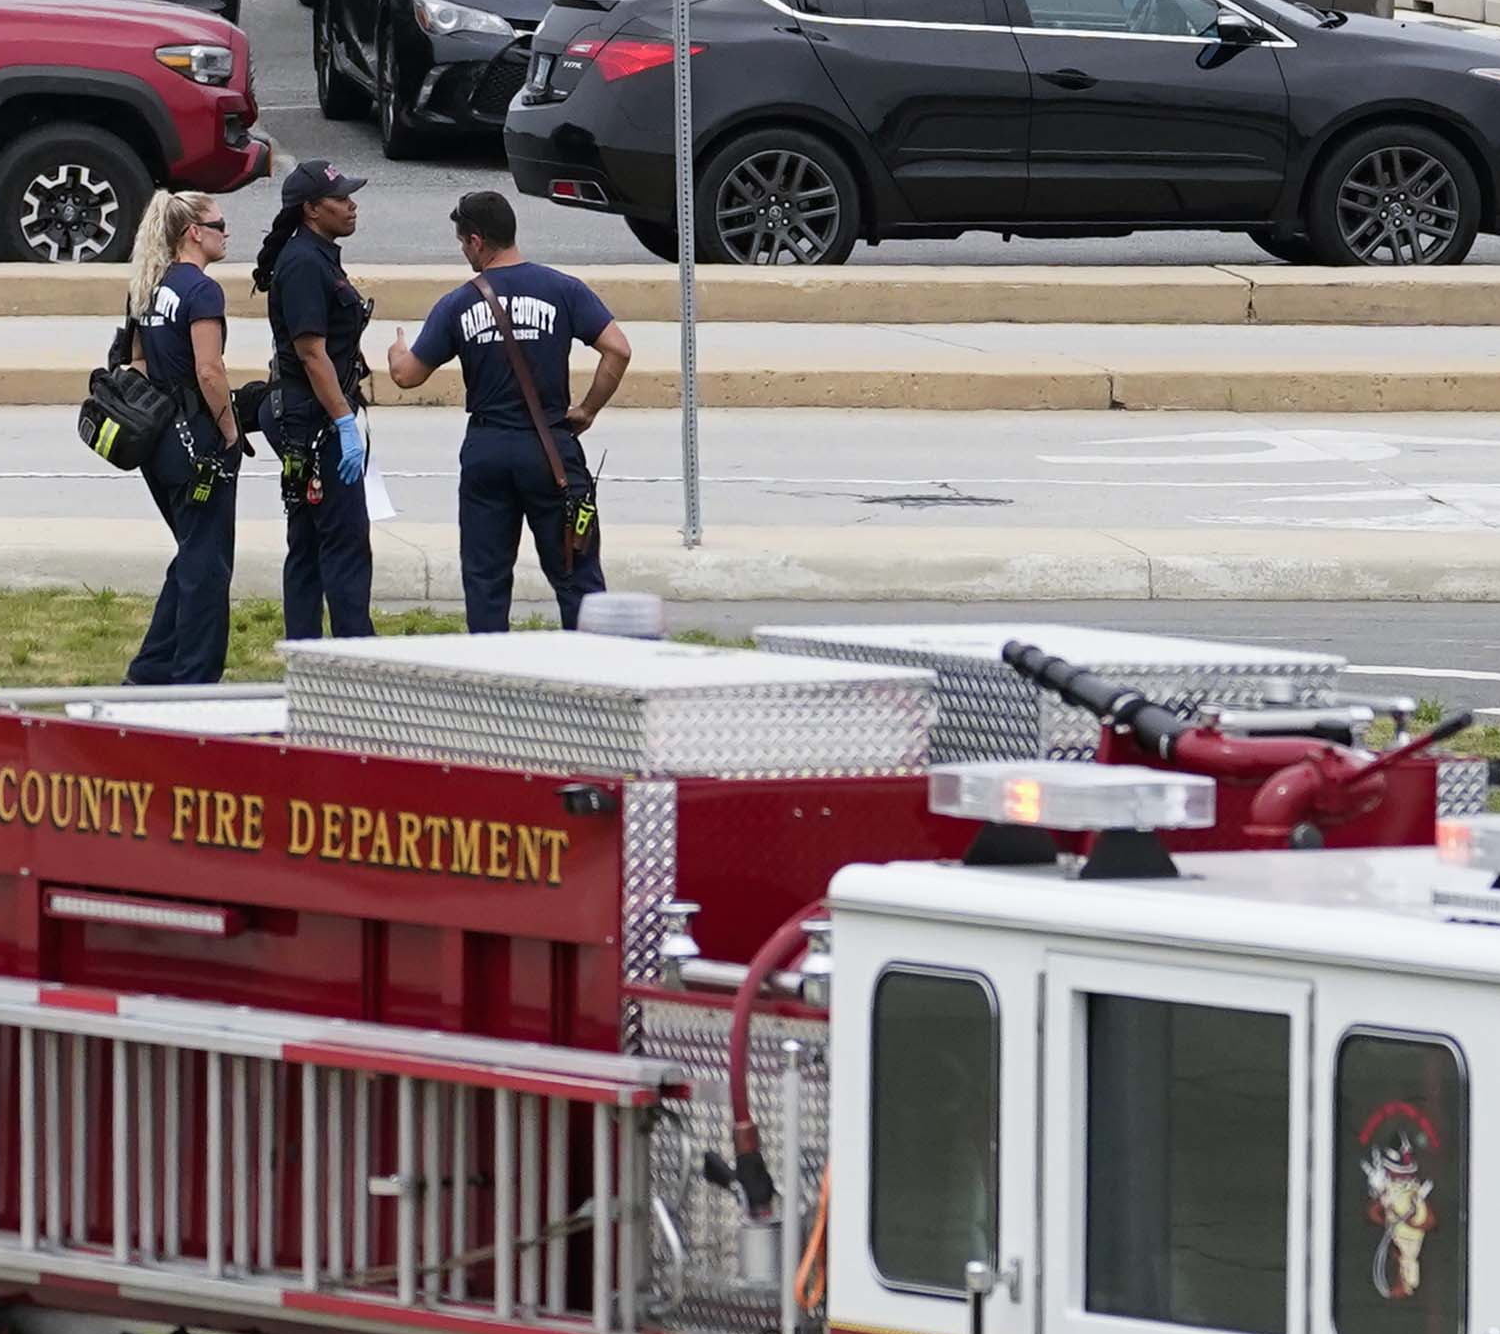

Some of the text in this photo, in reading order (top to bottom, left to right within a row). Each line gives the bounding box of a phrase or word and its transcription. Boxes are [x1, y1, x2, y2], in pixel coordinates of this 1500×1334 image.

[511, 296, 557, 336] COUNTY
[171, 785, 265, 854] FIRE
[287, 799, 570, 886] DEPARTMENT
